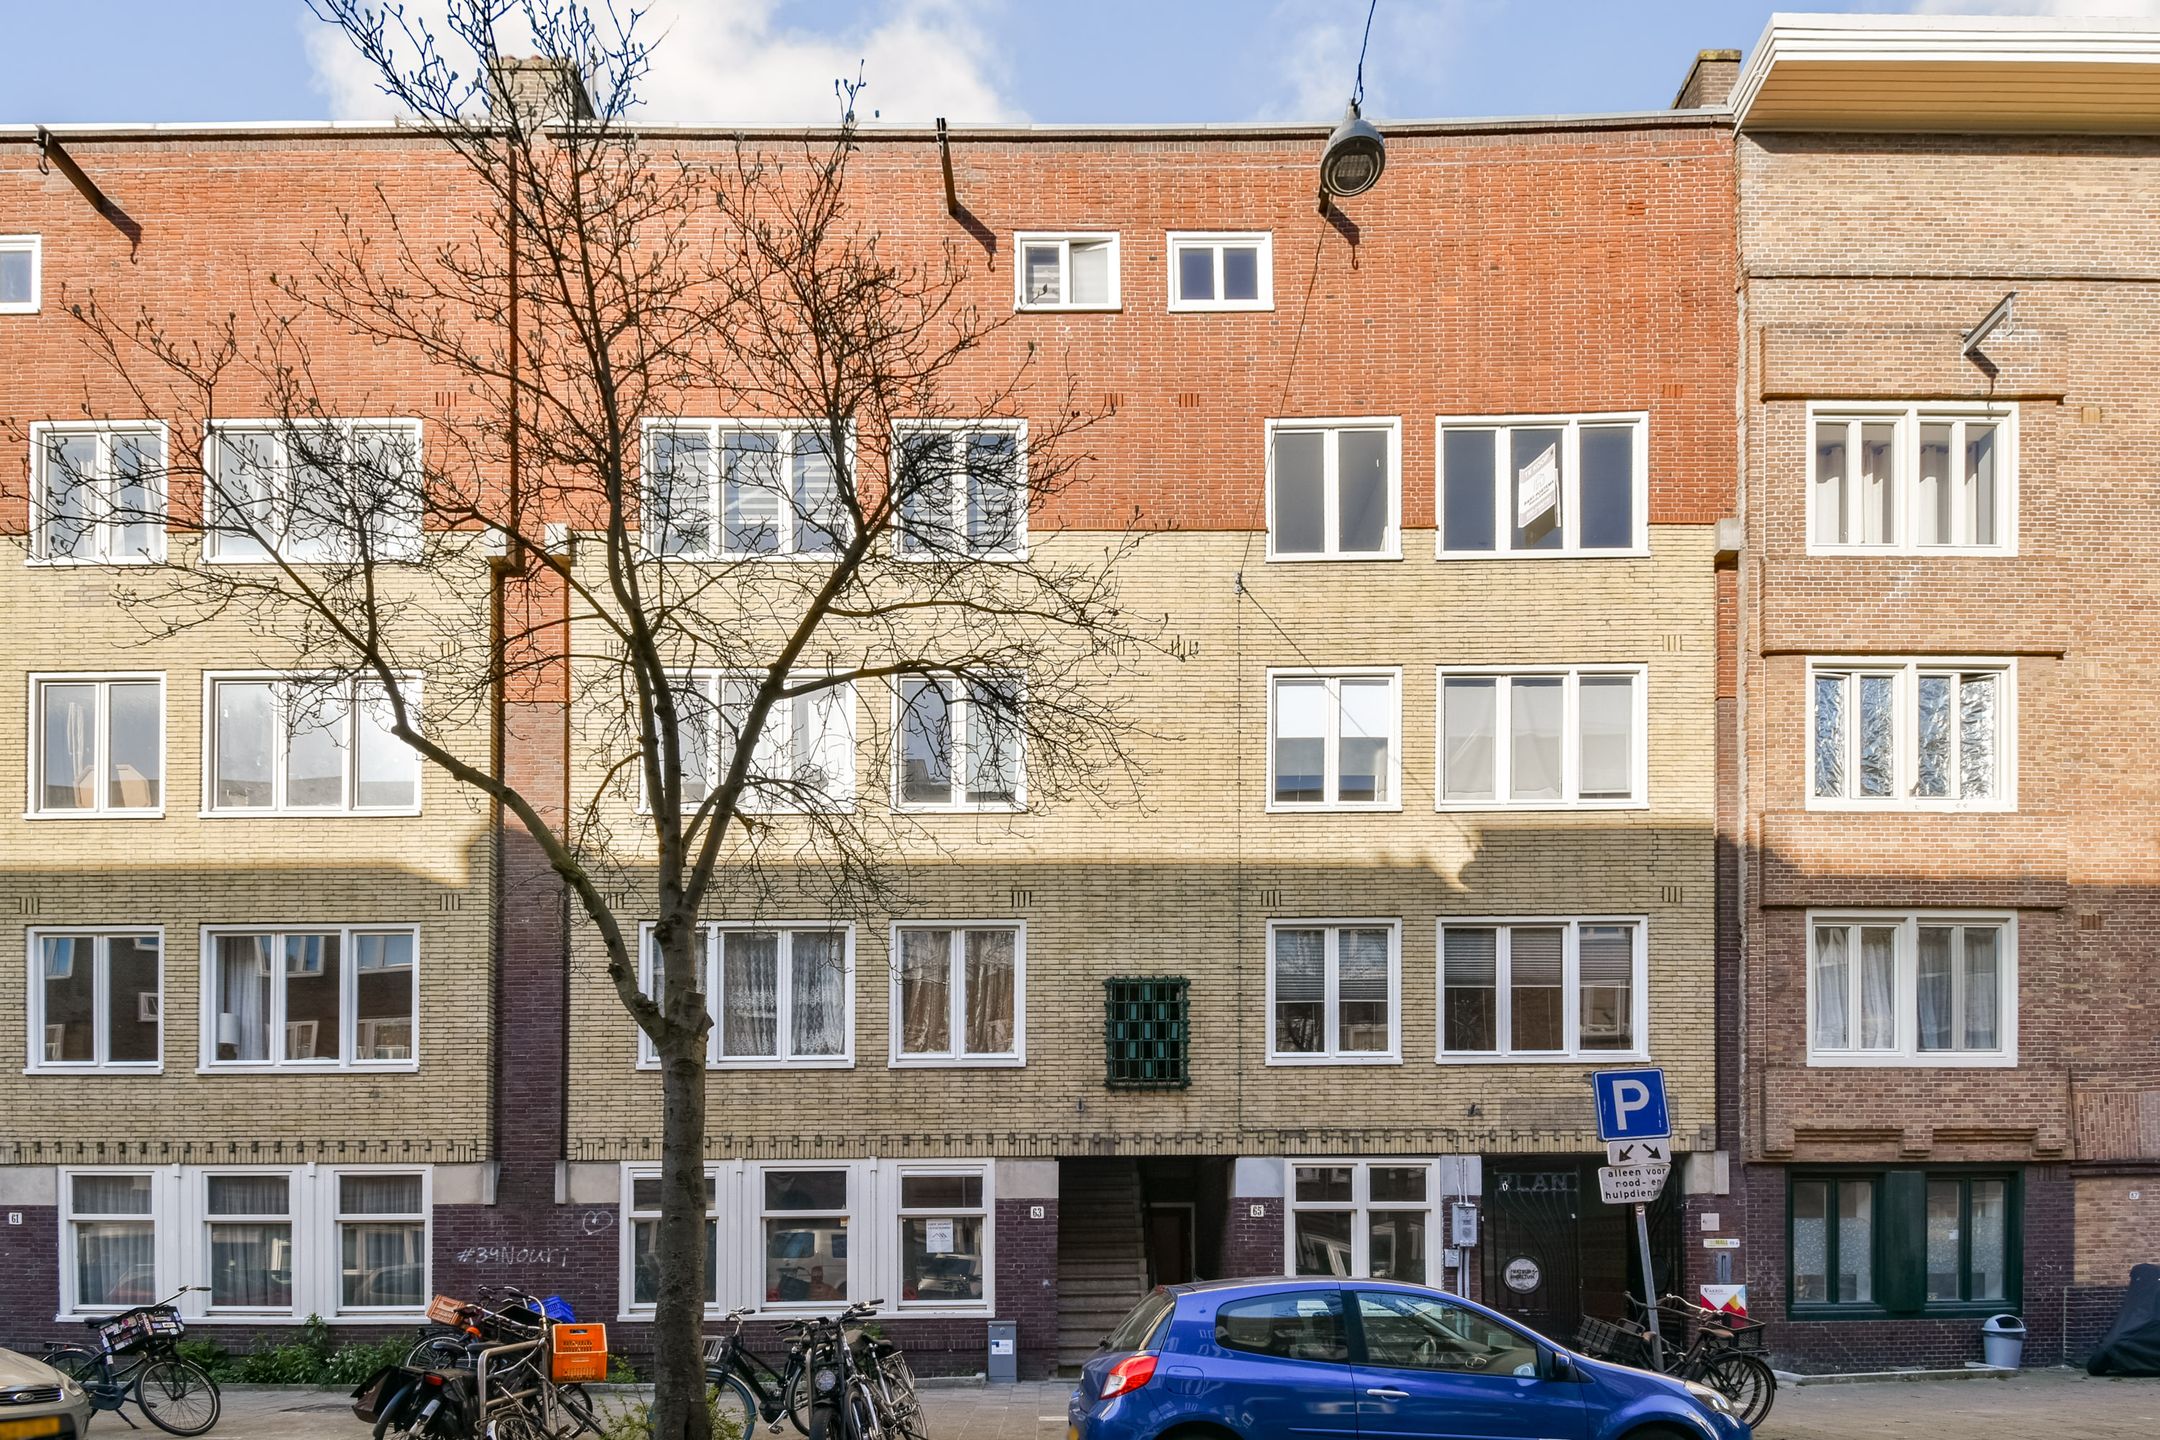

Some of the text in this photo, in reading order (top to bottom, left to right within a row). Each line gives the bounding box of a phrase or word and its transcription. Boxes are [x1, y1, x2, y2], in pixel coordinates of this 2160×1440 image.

[1612, 1079, 1650, 1131] P
[1608, 1168, 1666, 1178] alleen voor
[1033, 1207, 1042, 1217] 63
[1252, 1206, 1262, 1216] 65
[11, 1213, 19, 1223] 61
